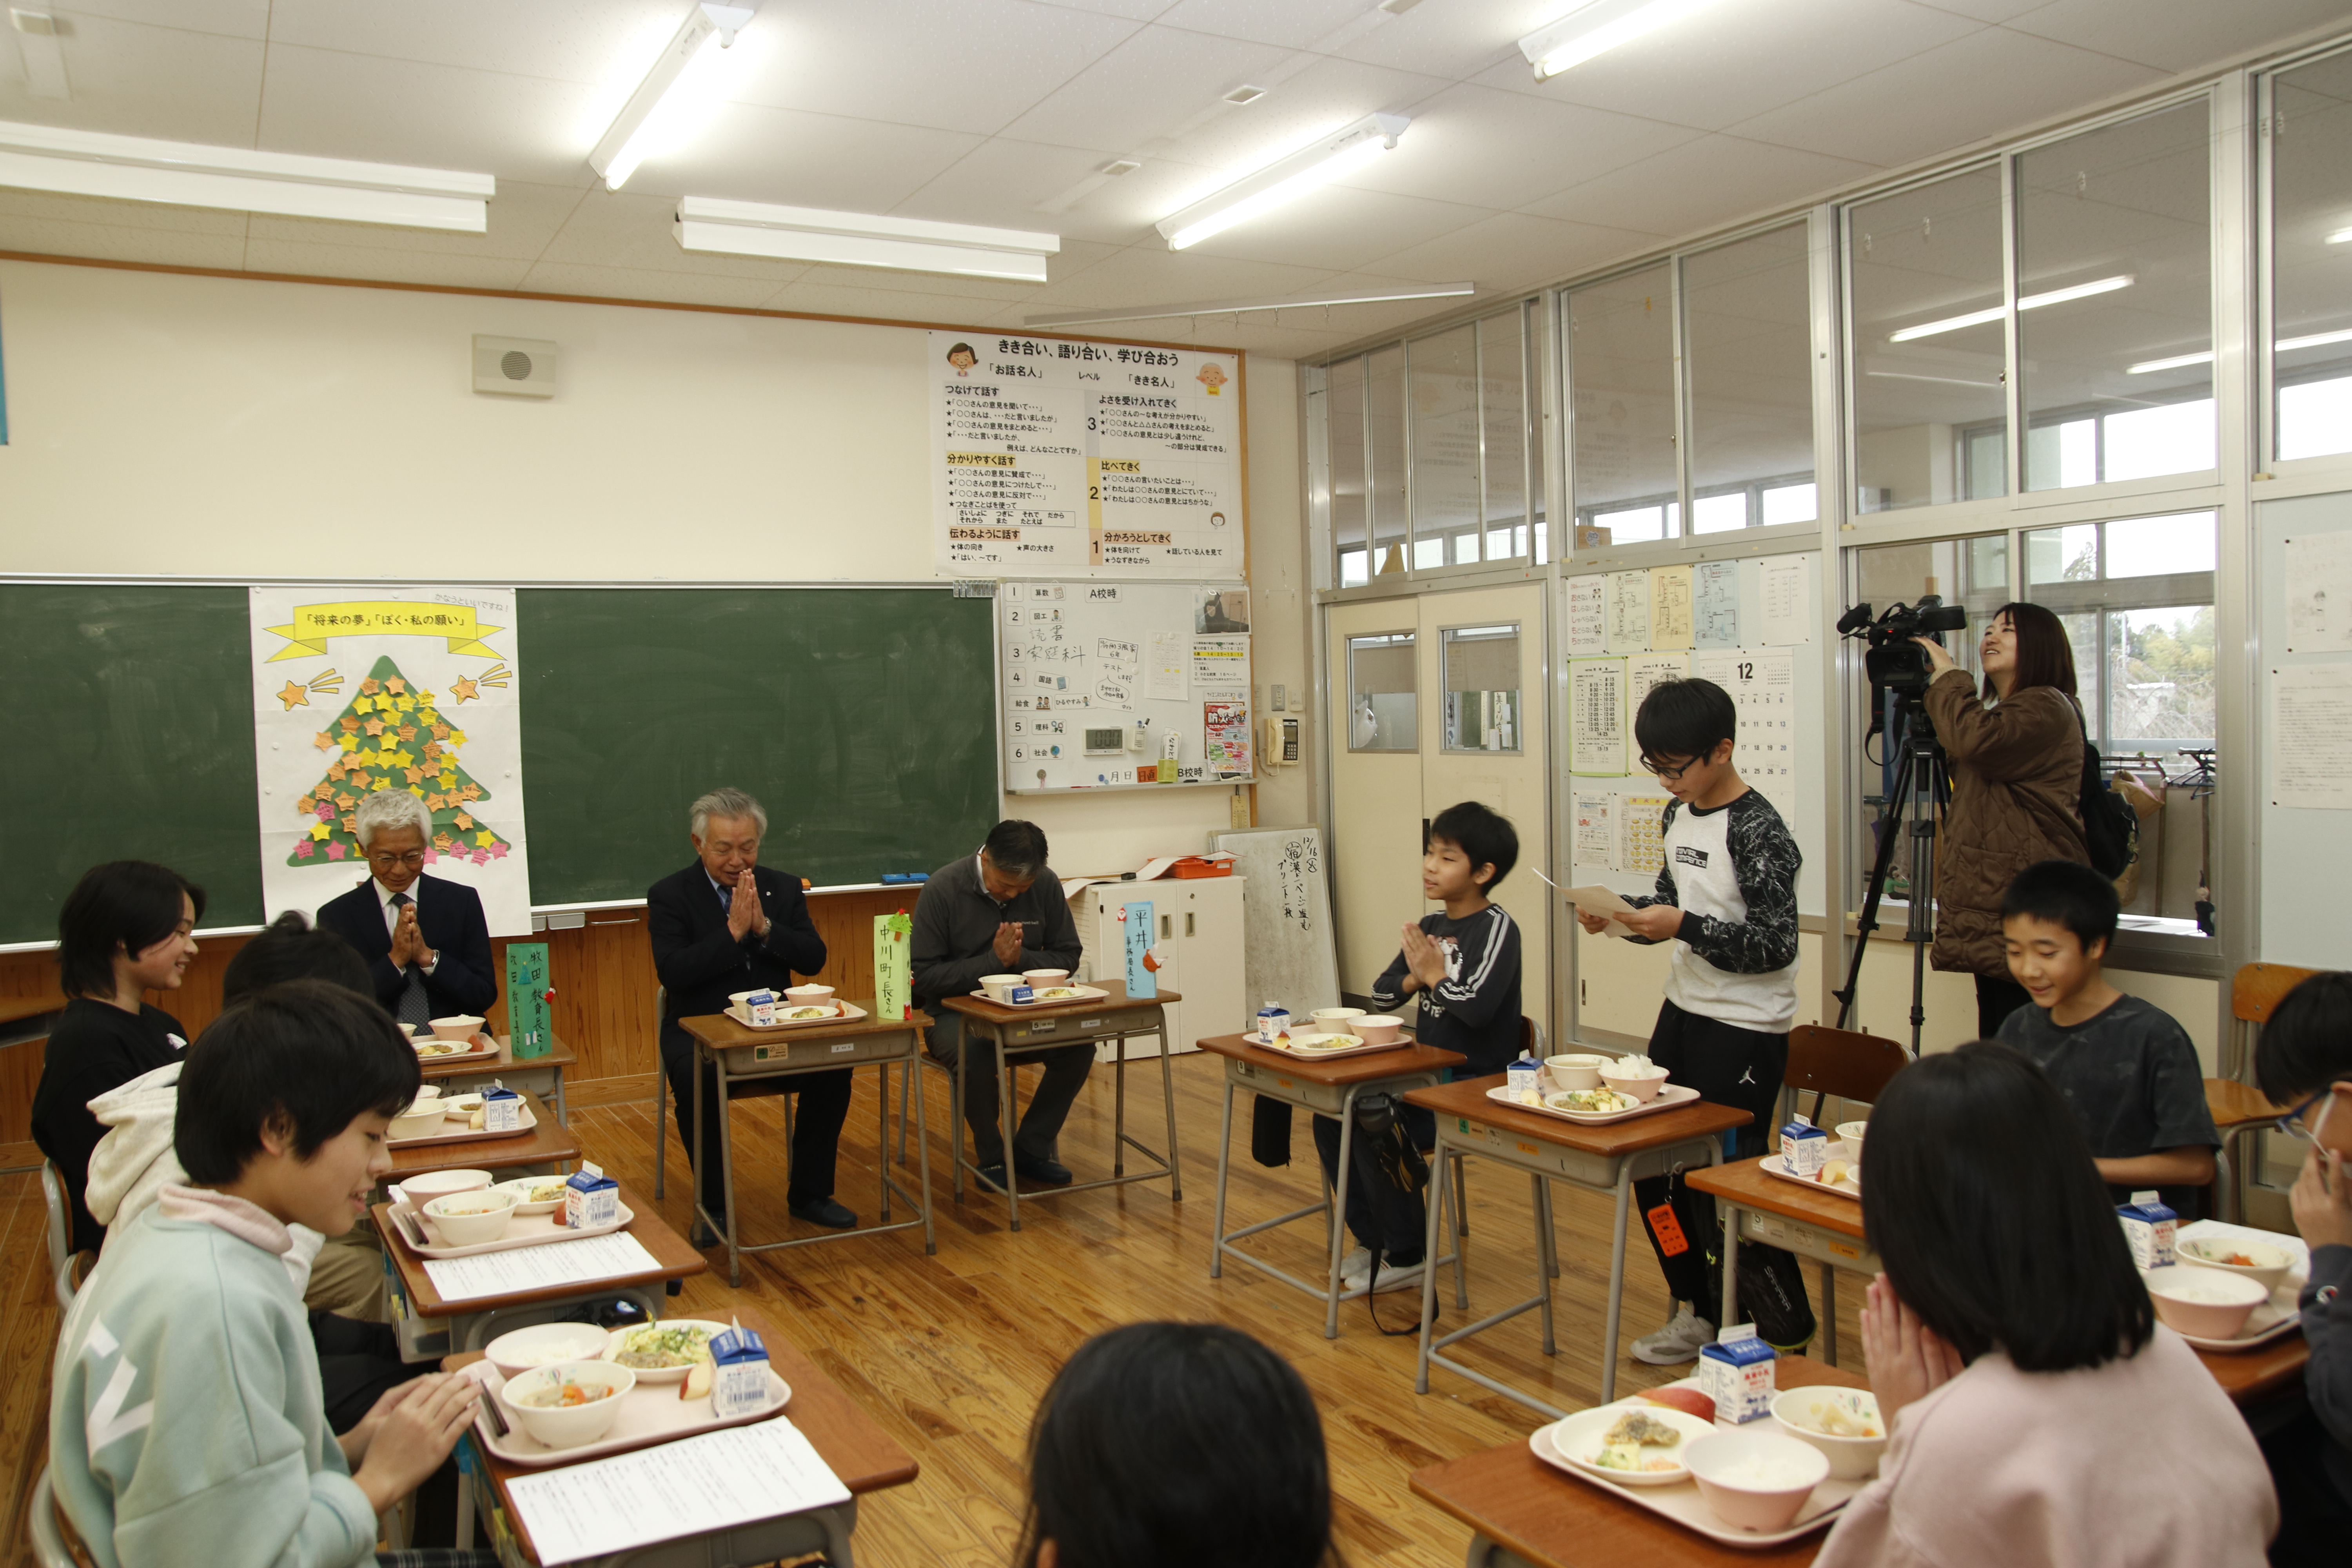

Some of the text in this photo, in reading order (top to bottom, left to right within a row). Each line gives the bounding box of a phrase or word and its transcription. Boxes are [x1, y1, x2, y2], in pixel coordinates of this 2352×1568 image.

[998, 339, 1178, 366] きき合い、語り合い、学び合おう
[989, 363, 1043, 378] 「お話名人」
[1078, 371, 1100, 381] レベル
[1129, 374, 1175, 388] 「きき名人」
[945, 385, 1000, 397] つなげて話す
[1099, 394, 1176, 408] よさを受け入れてきく
[1087, 417, 1096, 430] 3
[1007, 444, 1081, 455] 例えば、どんなことですか」
[947, 454, 1015, 465] 分かりやすく話す
[1101, 461, 1140, 471] 比べてきく
[1090, 486, 1098, 499] 2
[955, 501, 1017, 509] つなぎことばを使って
[950, 528, 1020, 539] 伝わるように話す
[1104, 532, 1171, 543] 分かろうとしてきく
[1092, 540, 1098, 554] 1
[1172, 548, 1222, 556] 話している人を見て
[1013, 587, 1016, 596] 1
[1090, 588, 1117, 599] A校時
[1012, 612, 1018, 621] 2
[1029, 625, 1064, 642] 読書
[1013, 648, 1020, 658] 3
[1027, 644, 1086, 667] 家庭科
[1103, 663, 1122, 673] テスト
[1737, 662, 1753, 679] 12
[1013, 672, 1020, 682] 4
[1038, 675, 1052, 684] 国語
[1015, 722, 1021, 731] 5
[1016, 748, 1022, 758] 6
[1111, 771, 1131, 782] 月 日
[1139, 769, 1156, 782] 日直
[1178, 766, 1203, 777] B校時
[1134, 910, 1147, 949] 平井
[880, 924, 894, 1013] 中川町長さん
